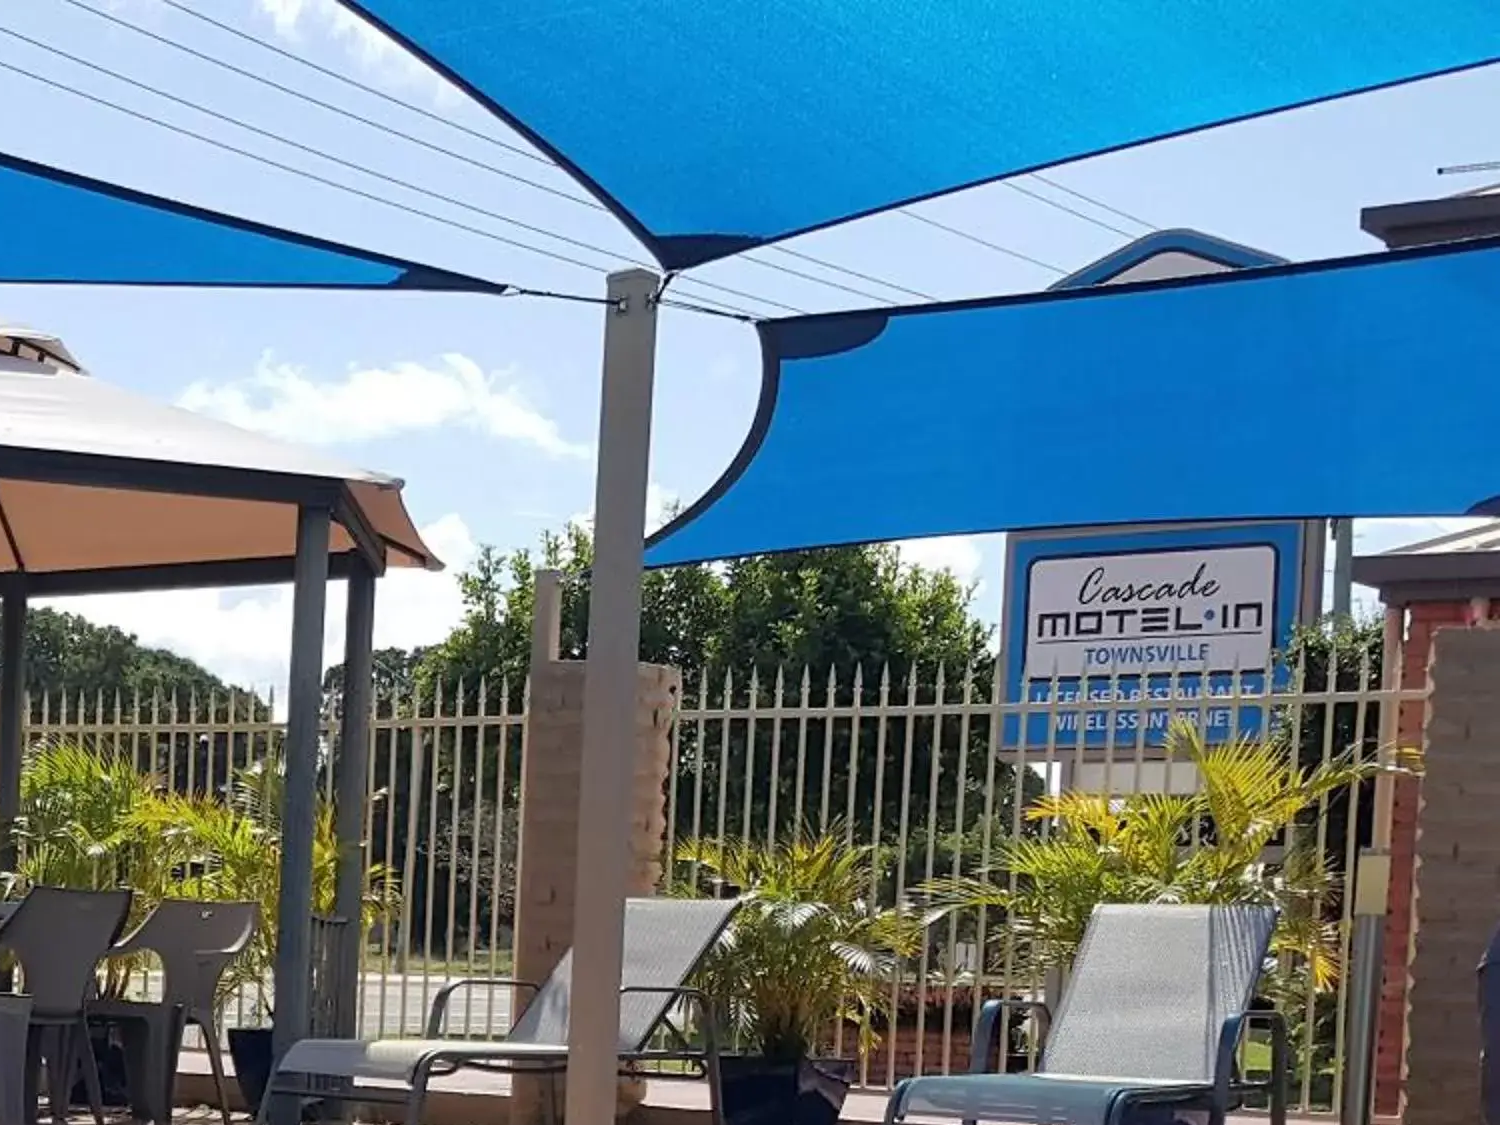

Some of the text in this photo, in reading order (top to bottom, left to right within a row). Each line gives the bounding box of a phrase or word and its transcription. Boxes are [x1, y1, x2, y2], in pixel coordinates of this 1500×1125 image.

[1079, 563, 1220, 604] Cascade
[1085, 644, 1210, 664] TOWNSVILLE
[1053, 712, 1140, 731] WIELSS
